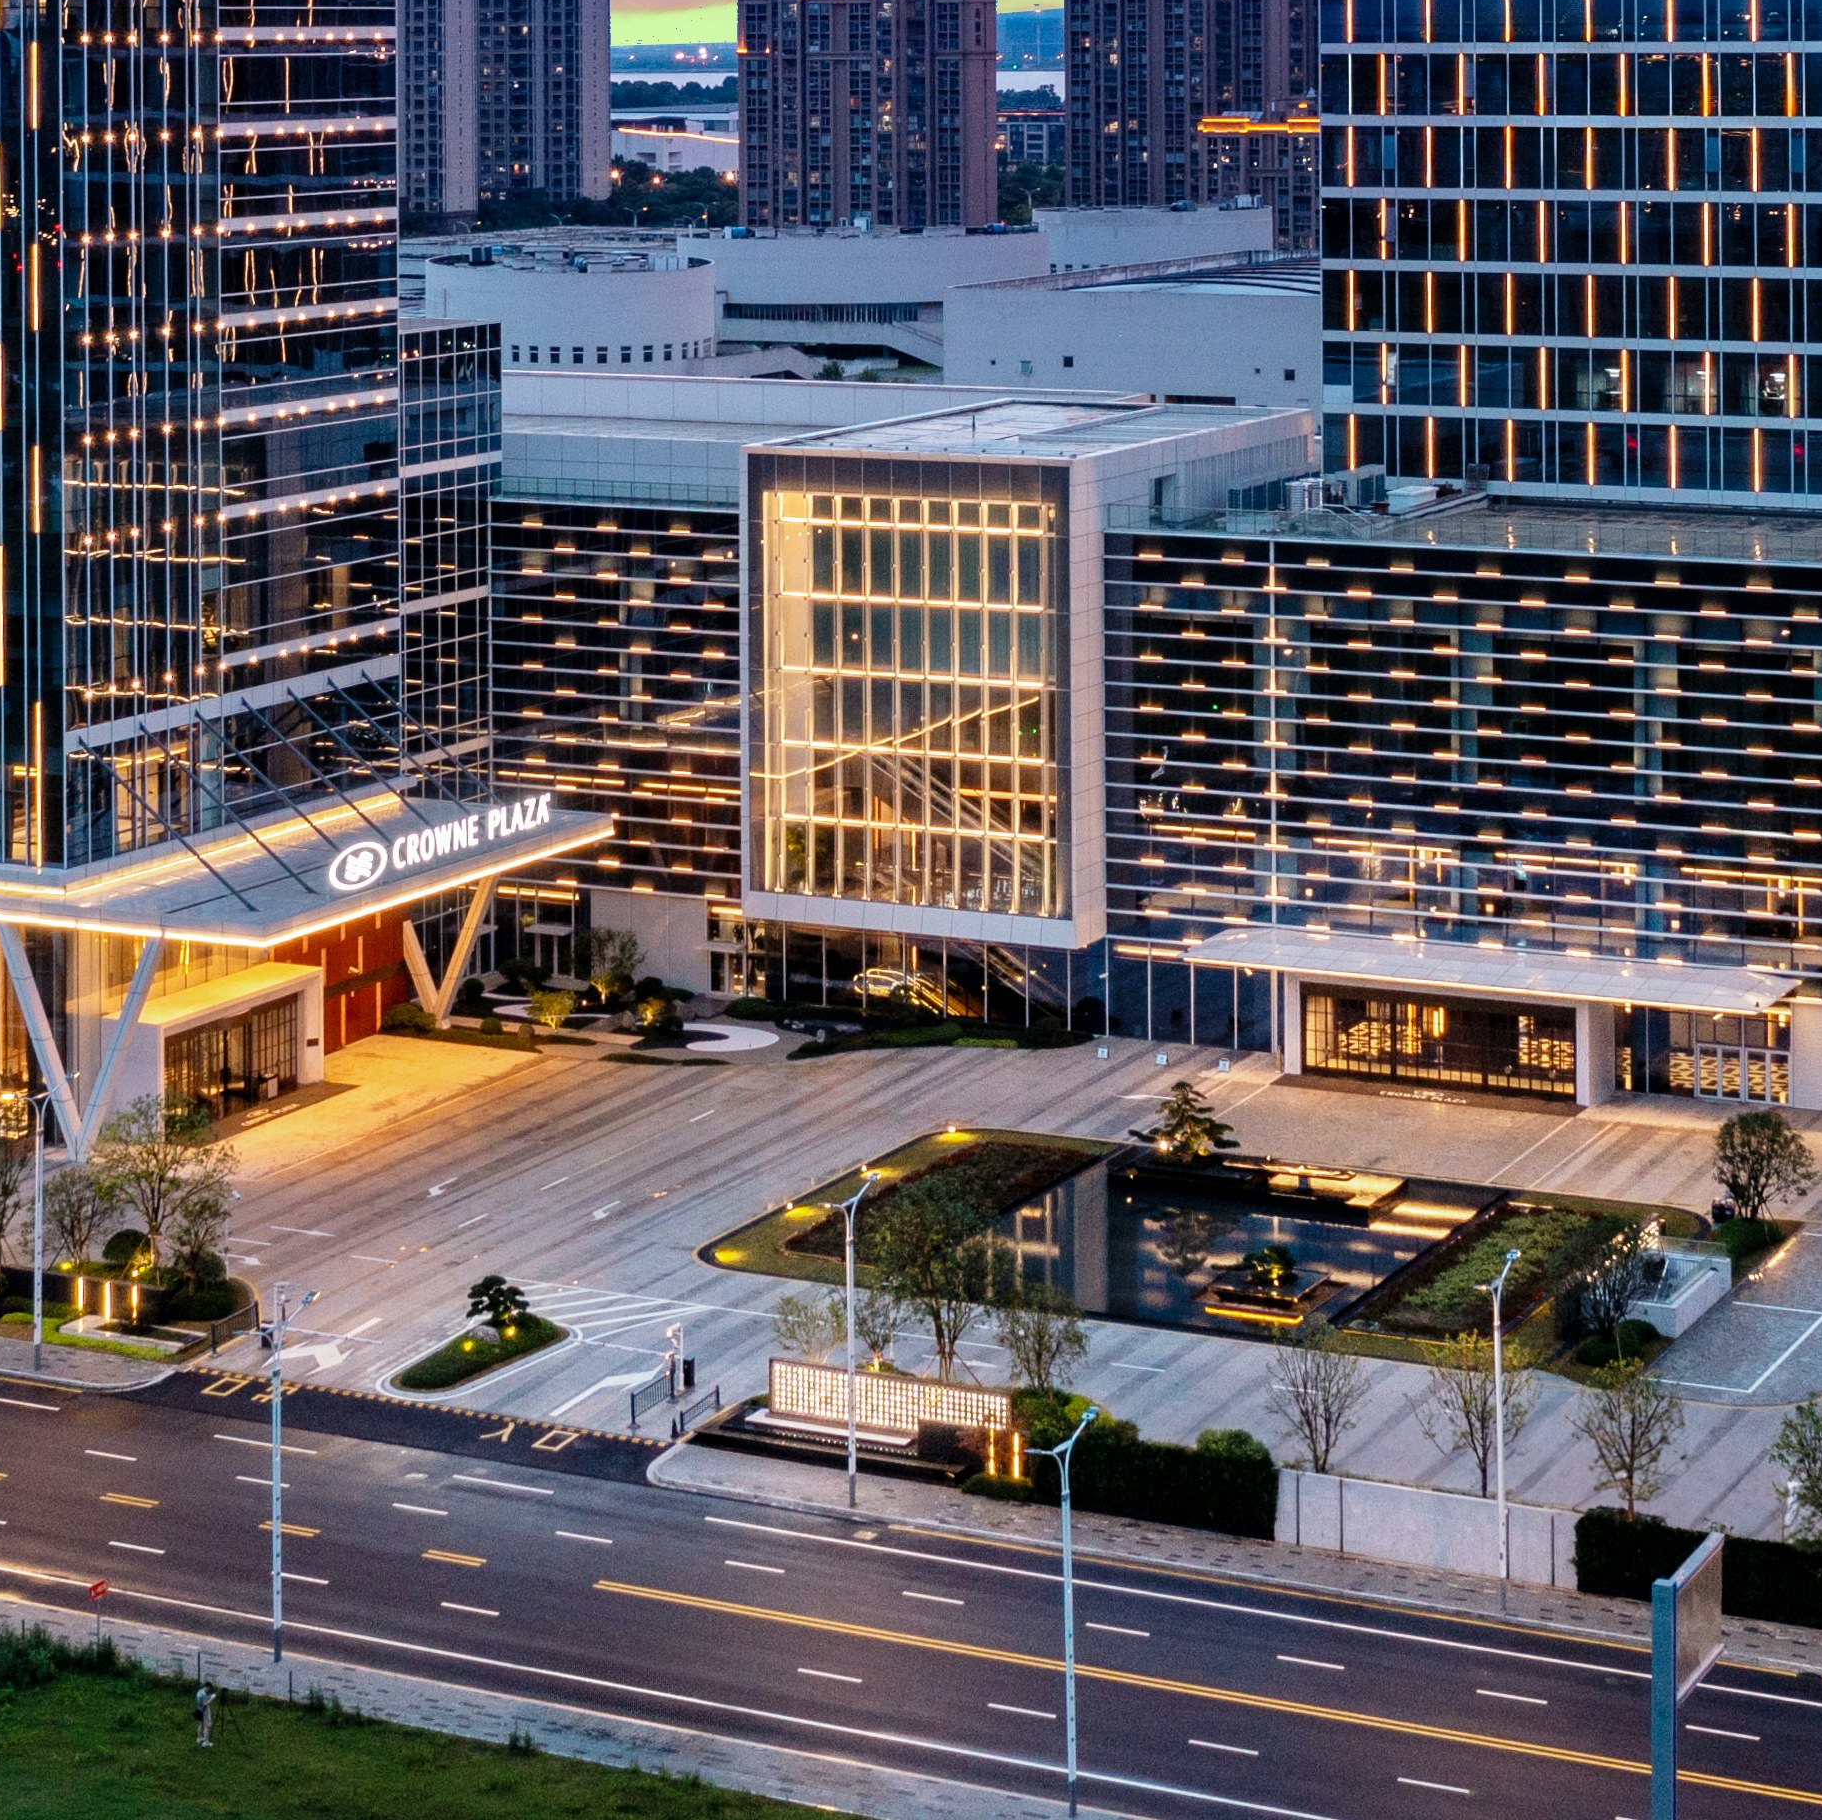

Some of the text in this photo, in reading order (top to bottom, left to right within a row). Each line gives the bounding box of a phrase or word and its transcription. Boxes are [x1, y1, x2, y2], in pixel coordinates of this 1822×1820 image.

[392, 792, 552, 870] CROWNE PLAZA
[479, 1421, 581, 1452] 入口
